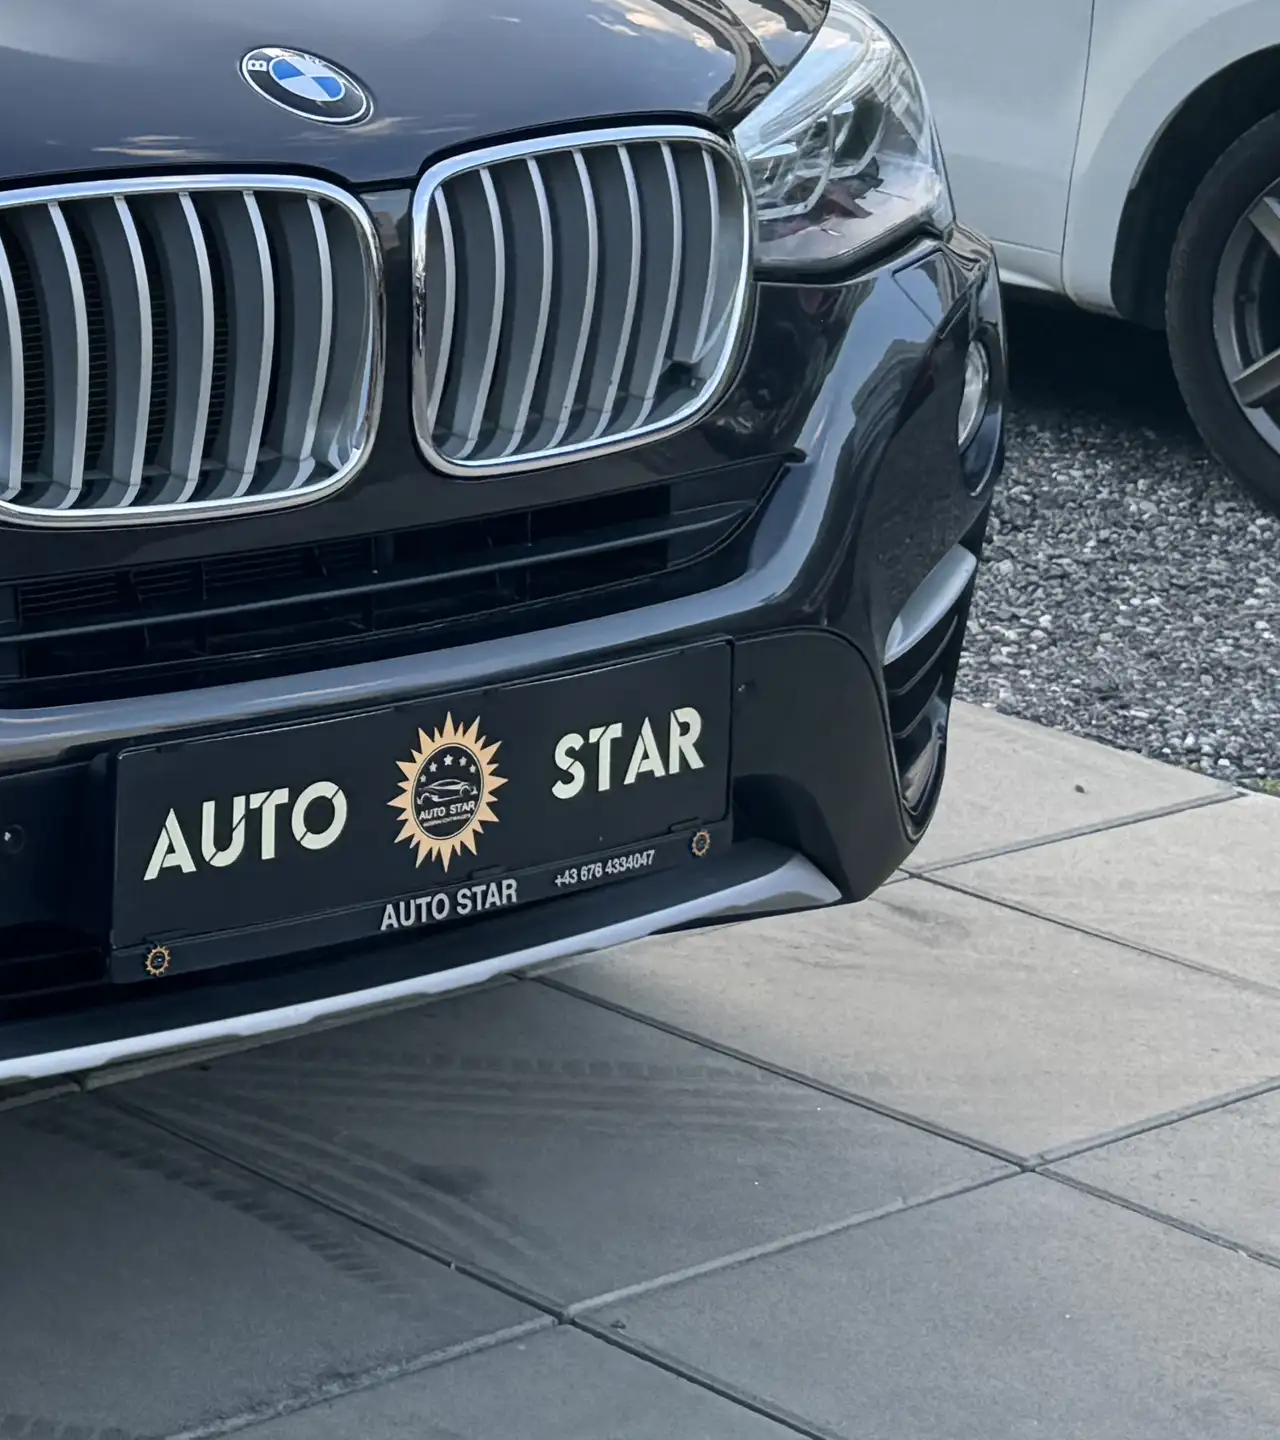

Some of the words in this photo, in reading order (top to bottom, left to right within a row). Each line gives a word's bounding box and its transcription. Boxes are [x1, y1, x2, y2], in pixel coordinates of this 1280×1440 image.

[143, 780, 348, 880] AUTO
[551, 706, 705, 800] STAR
[419, 806, 446, 820] AUTO
[449, 800, 476, 814] STAR
[554, 868, 578, 887] +43
[605, 849, 656, 874] 4334047
[380, 893, 450, 931] AUTO
[456, 878, 518, 915] STAR
